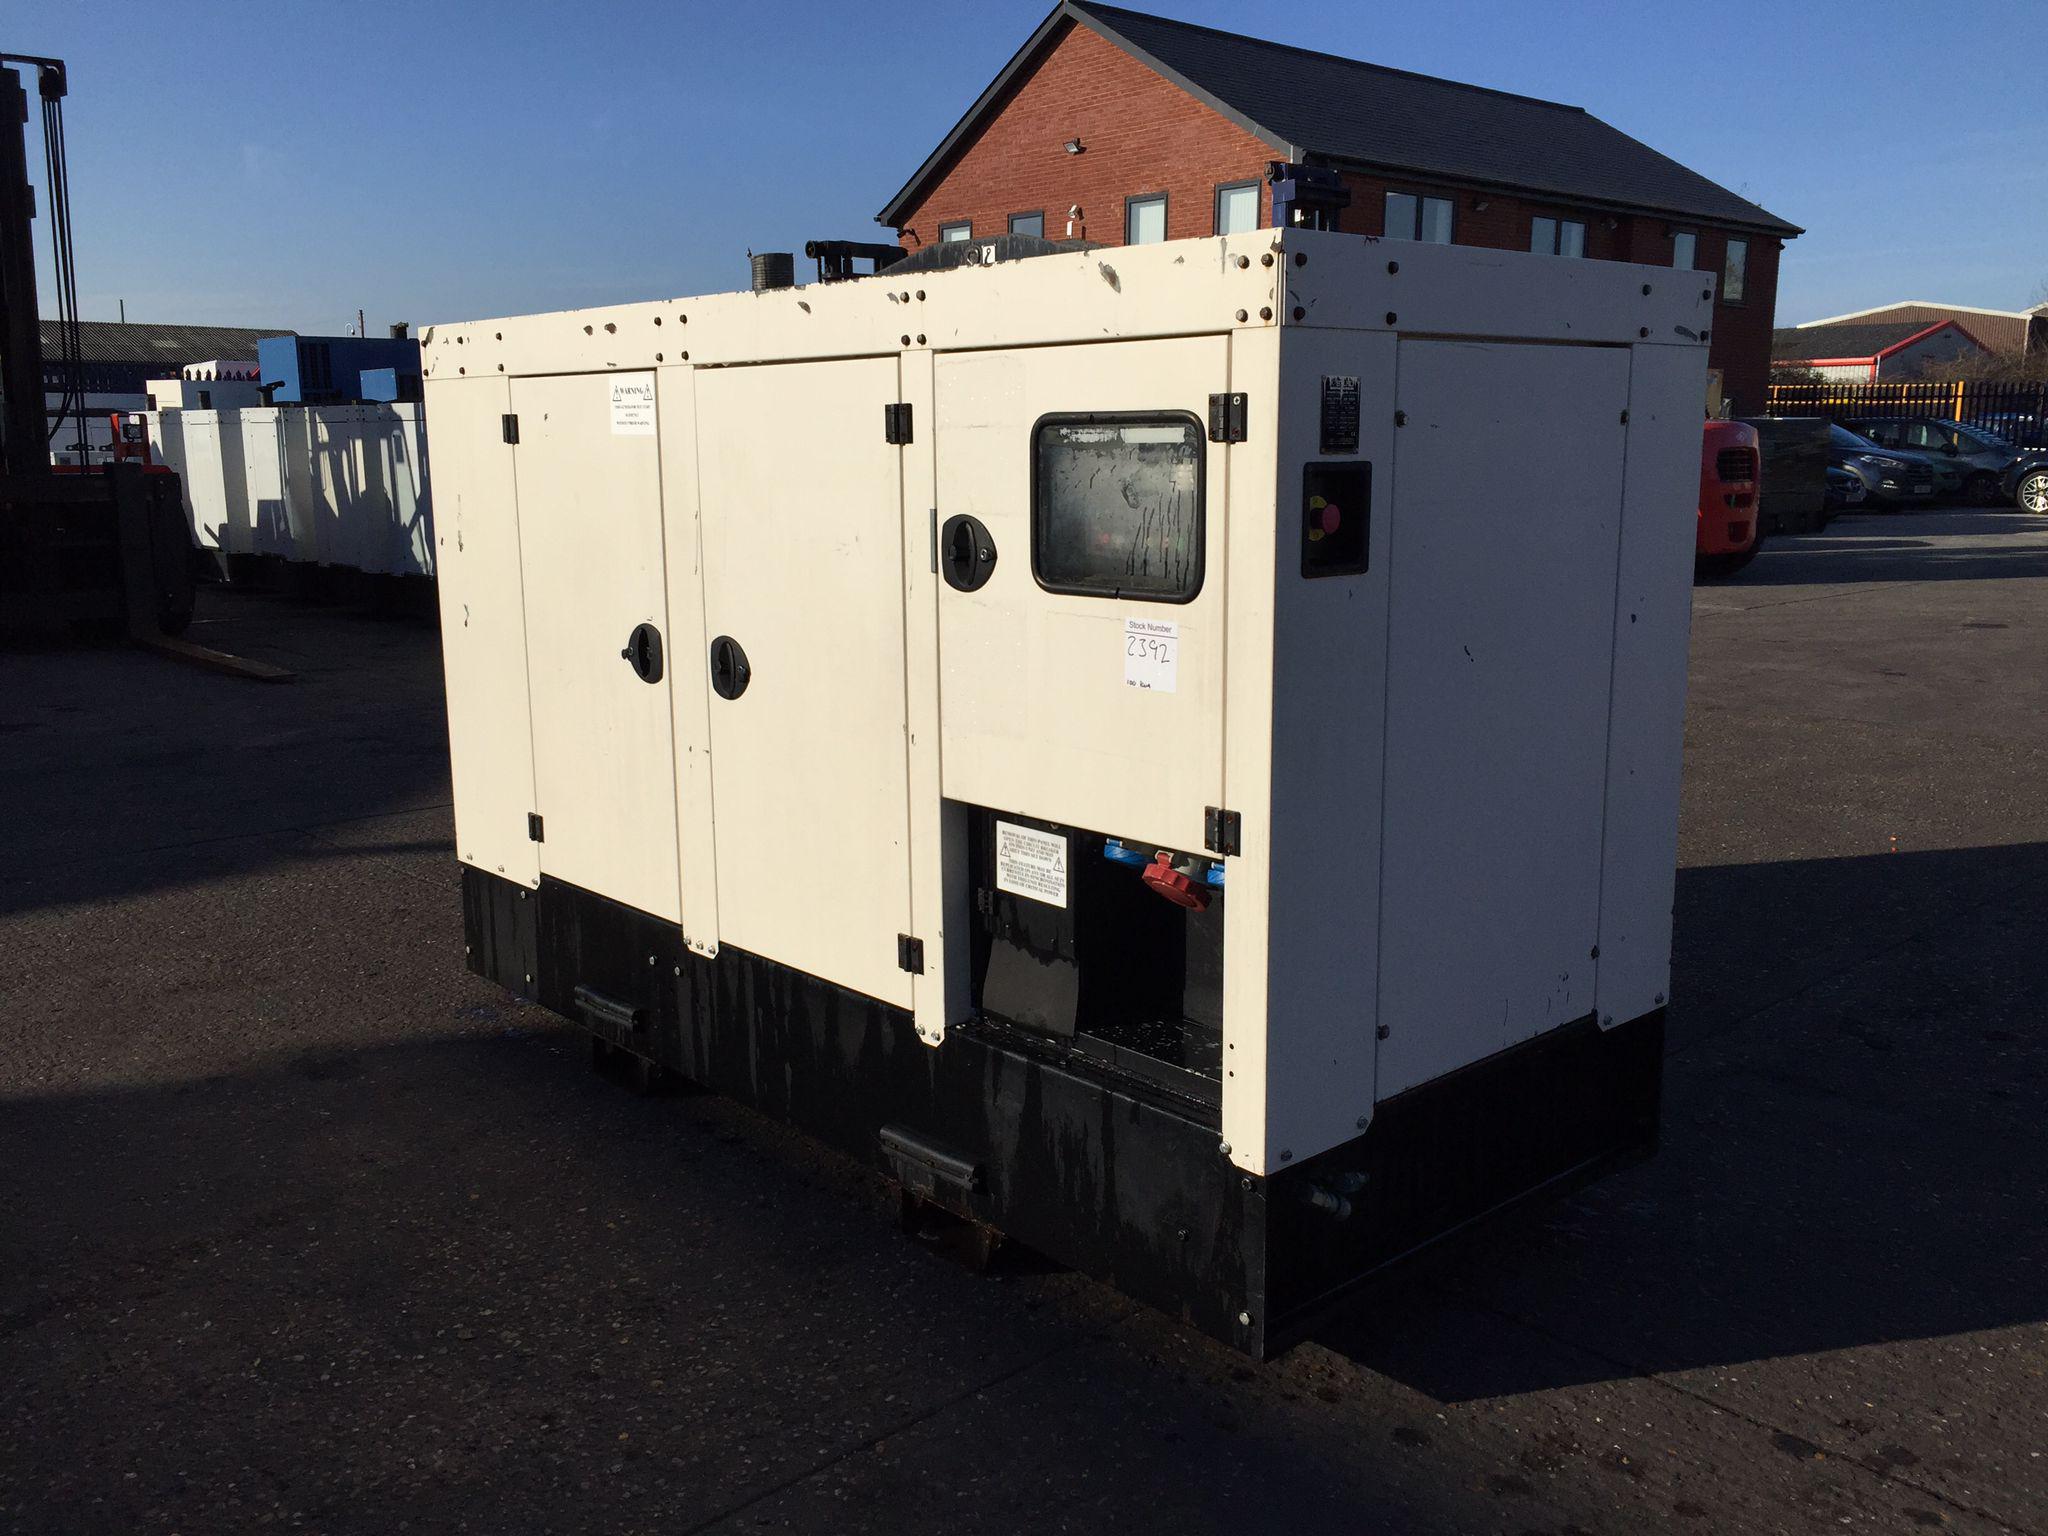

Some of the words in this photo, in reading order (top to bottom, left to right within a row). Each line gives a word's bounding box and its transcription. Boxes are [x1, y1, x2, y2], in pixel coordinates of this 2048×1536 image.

[1129, 621, 1146, 630] Stock
[1148, 623, 1172, 633] Number
[1128, 636, 1170, 663] 2392
